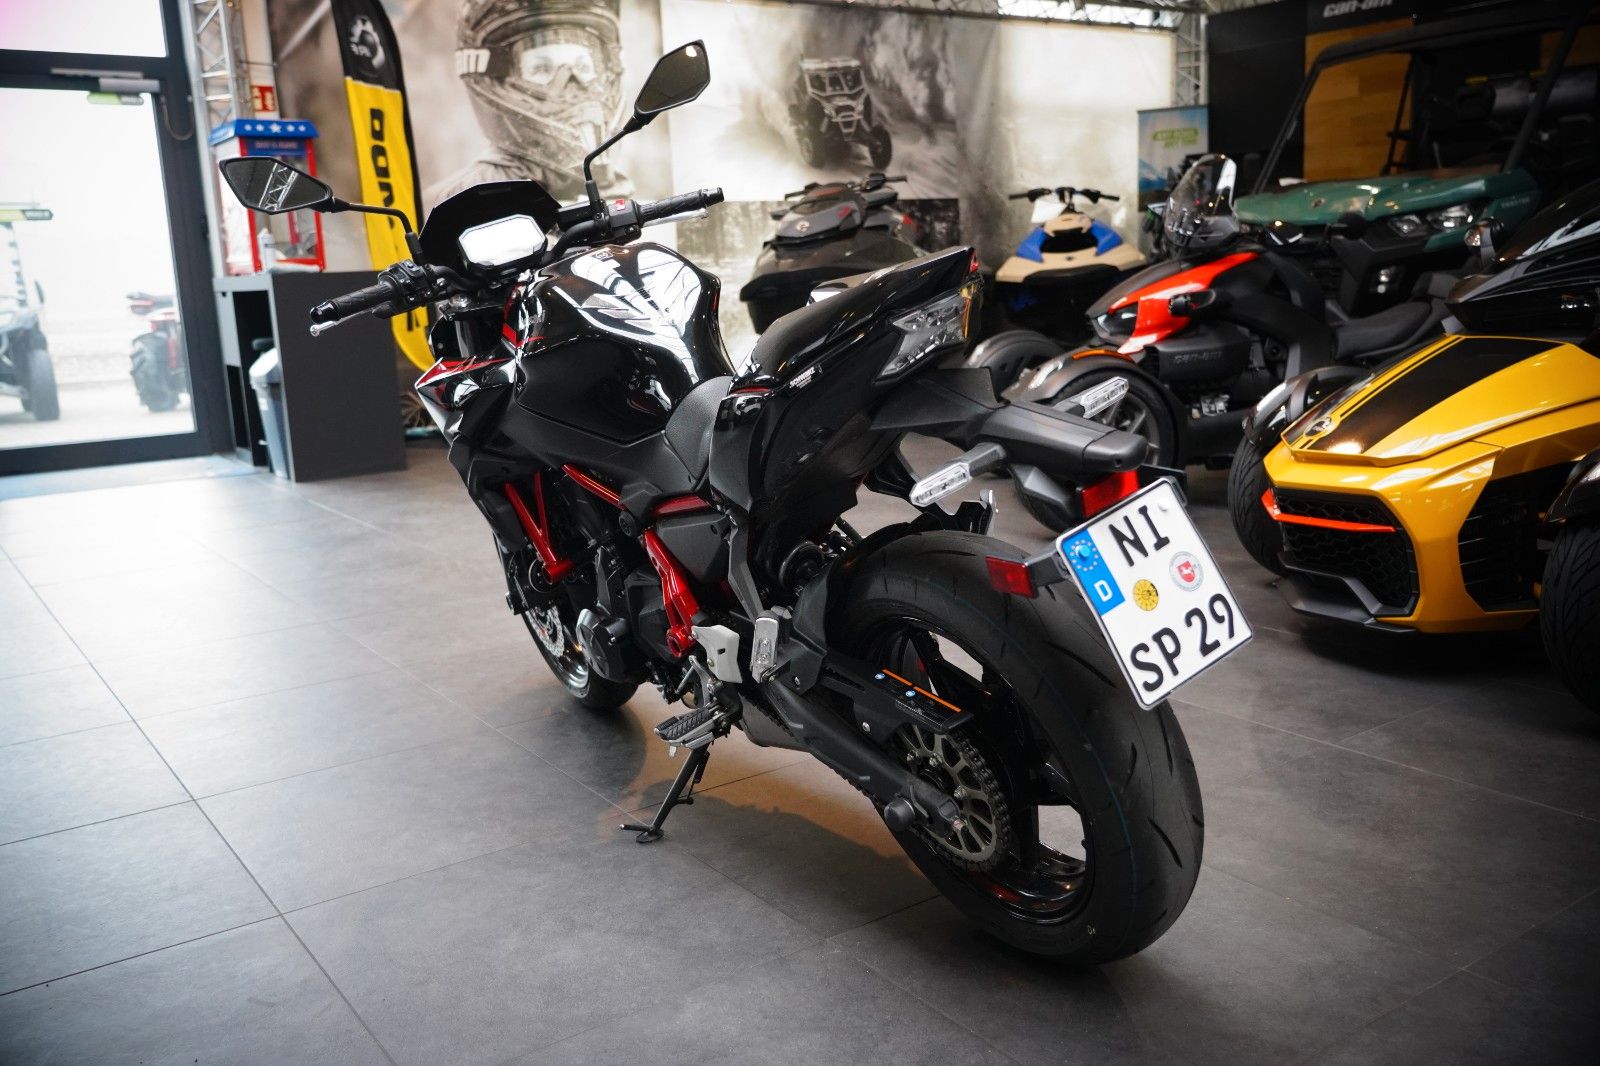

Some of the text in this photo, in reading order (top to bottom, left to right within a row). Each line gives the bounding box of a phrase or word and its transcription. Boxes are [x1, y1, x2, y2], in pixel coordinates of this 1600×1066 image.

[1108, 504, 1170, 568] NI
[1093, 579, 1114, 603] D
[1130, 593, 1235, 692] SP 29
